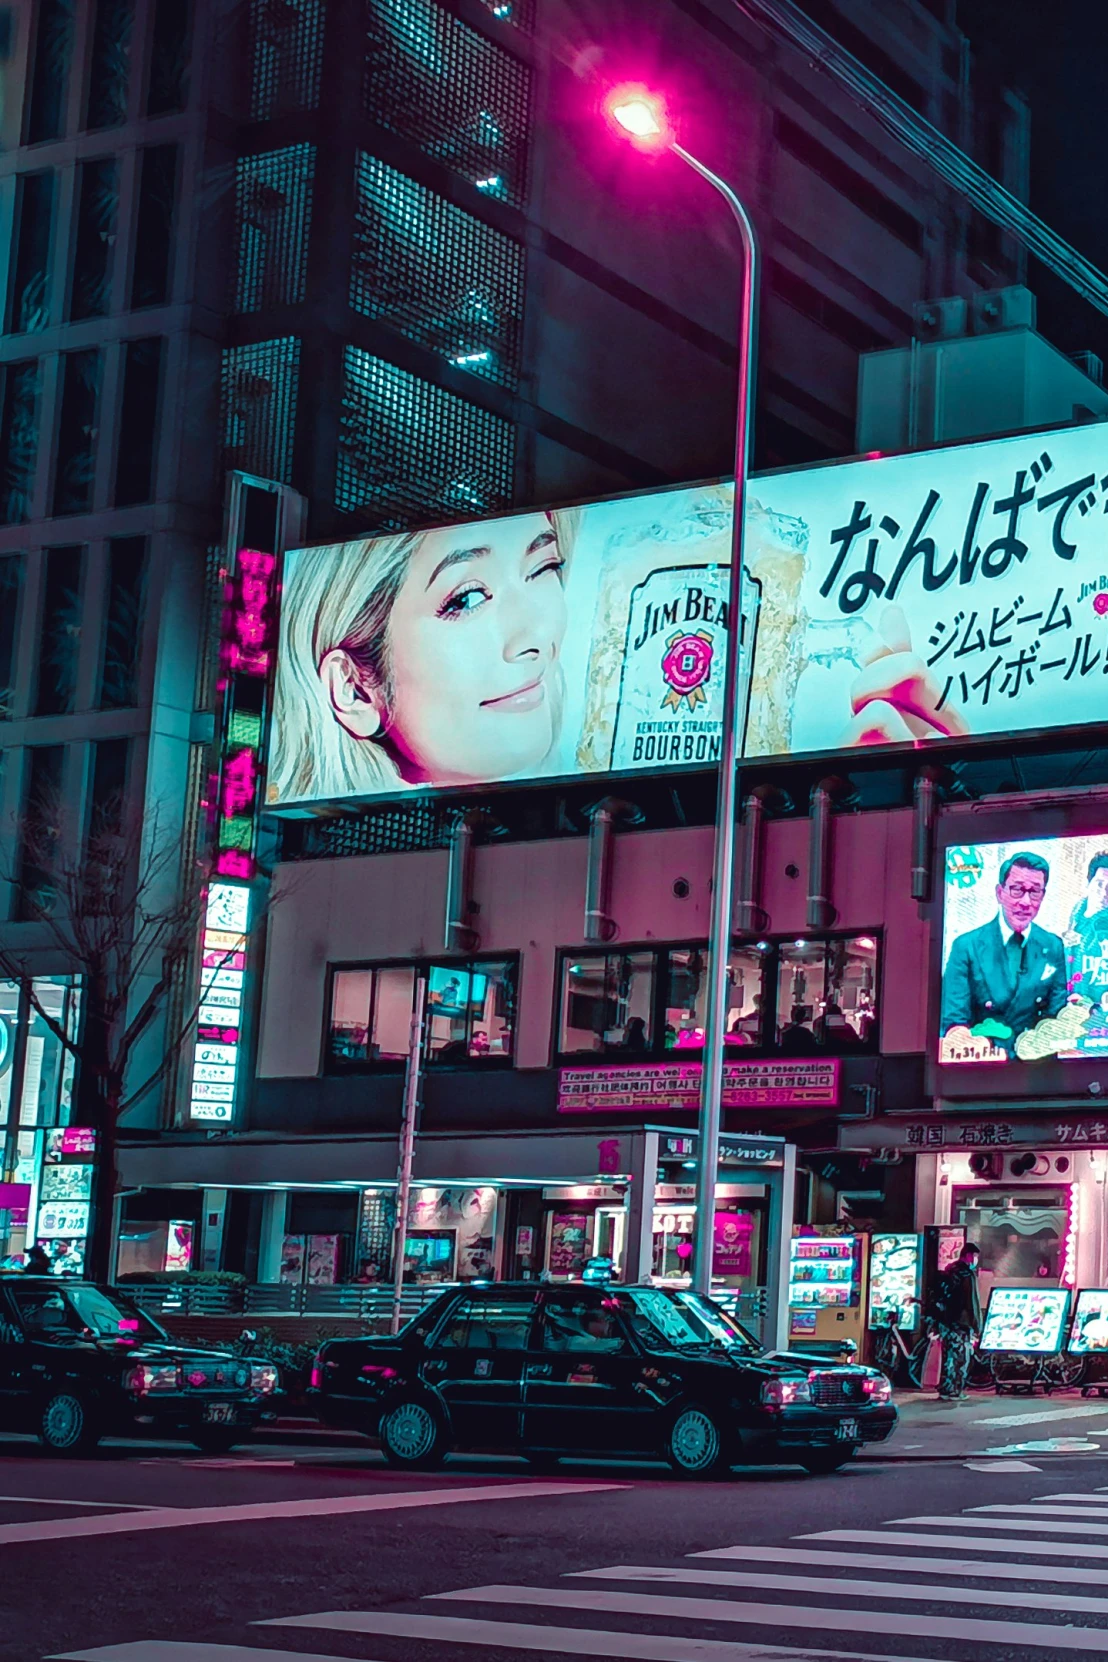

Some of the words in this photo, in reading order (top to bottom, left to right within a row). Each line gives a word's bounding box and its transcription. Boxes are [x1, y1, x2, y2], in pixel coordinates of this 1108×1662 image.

[1077, 579, 1097, 603] JIM
[634, 597, 682, 651] JIM
[926, 587, 1073, 667] ジムビーム
[636, 720, 679, 734] KENTUCKY
[633, 734, 722, 762] BOURBON
[982, 1046, 1001, 1058] FRI
[563, 1071, 595, 1081] Travel
[597, 1069, 642, 1080] agencies
[643, 1070, 660, 1078] are
[730, 1064, 760, 1075] make
[771, 1063, 833, 1074] reservation
[958, 1123, 1014, 1146] 石焼き
